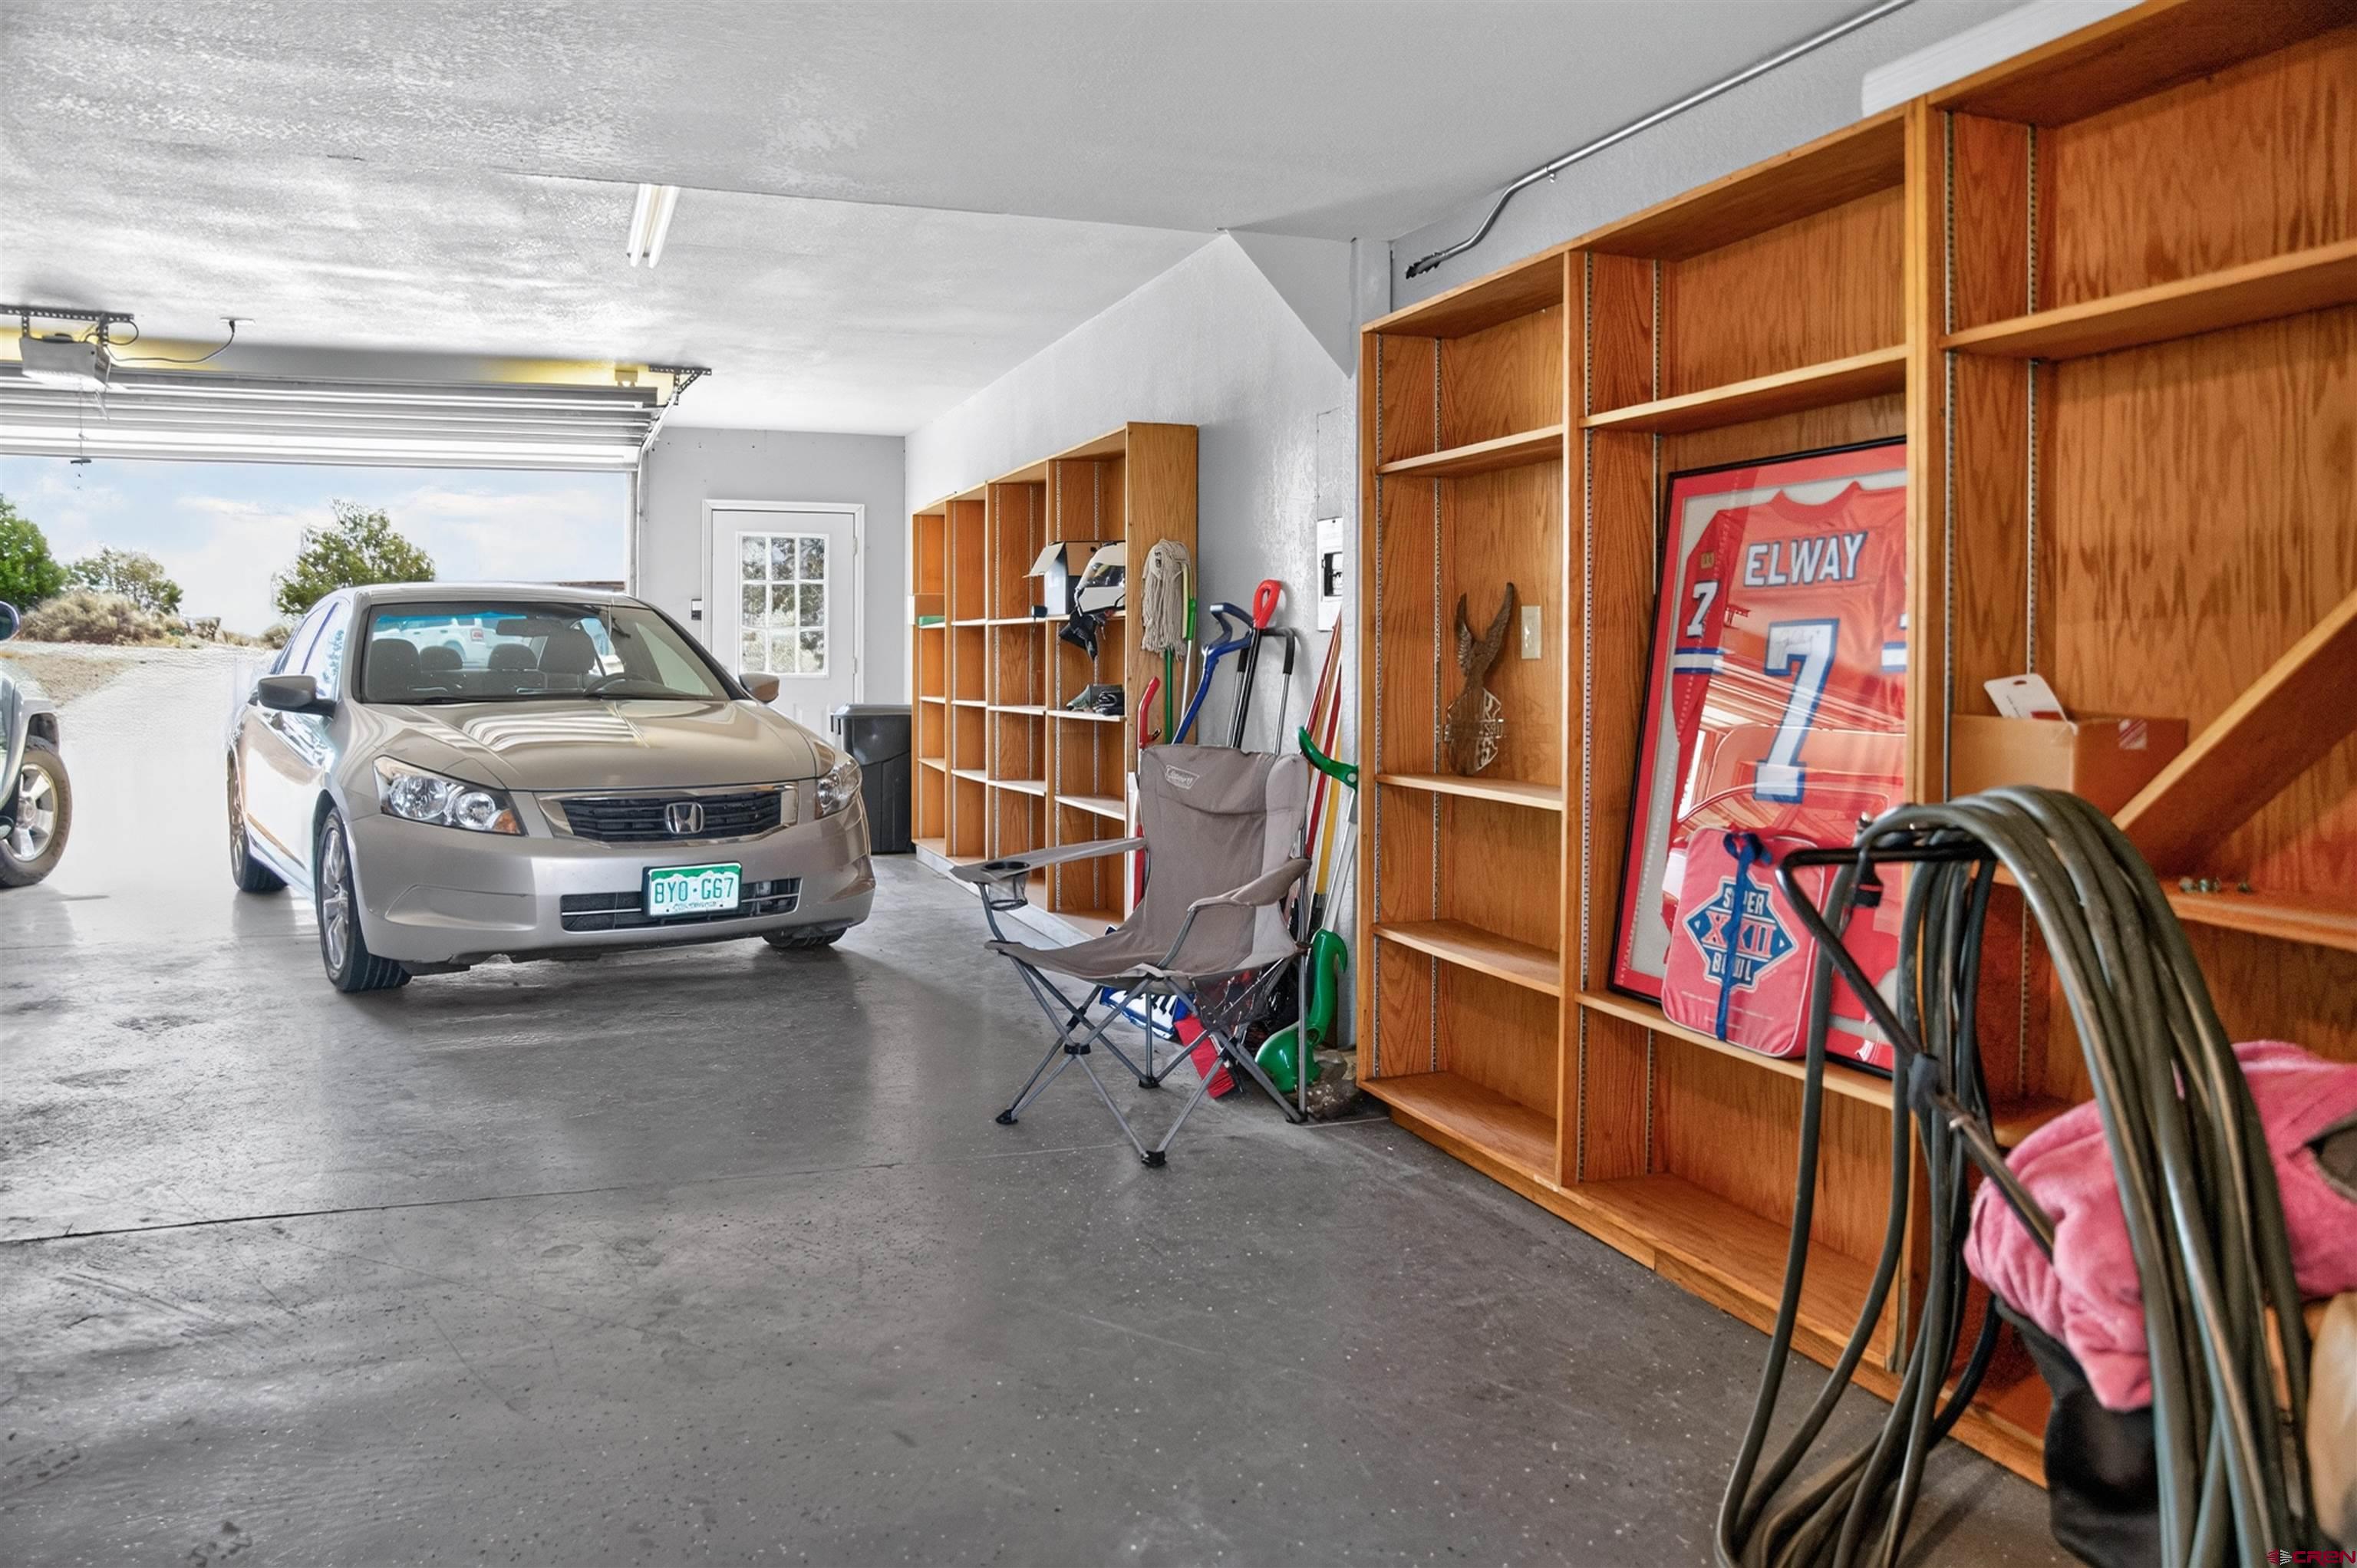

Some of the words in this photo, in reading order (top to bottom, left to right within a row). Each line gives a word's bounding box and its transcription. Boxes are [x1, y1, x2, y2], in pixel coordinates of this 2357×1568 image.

[1743, 531, 1868, 588] ELWAY
[1686, 579, 1719, 638] 7
[1753, 618, 1840, 804] 7
[1722, 886, 1765, 915] SER
